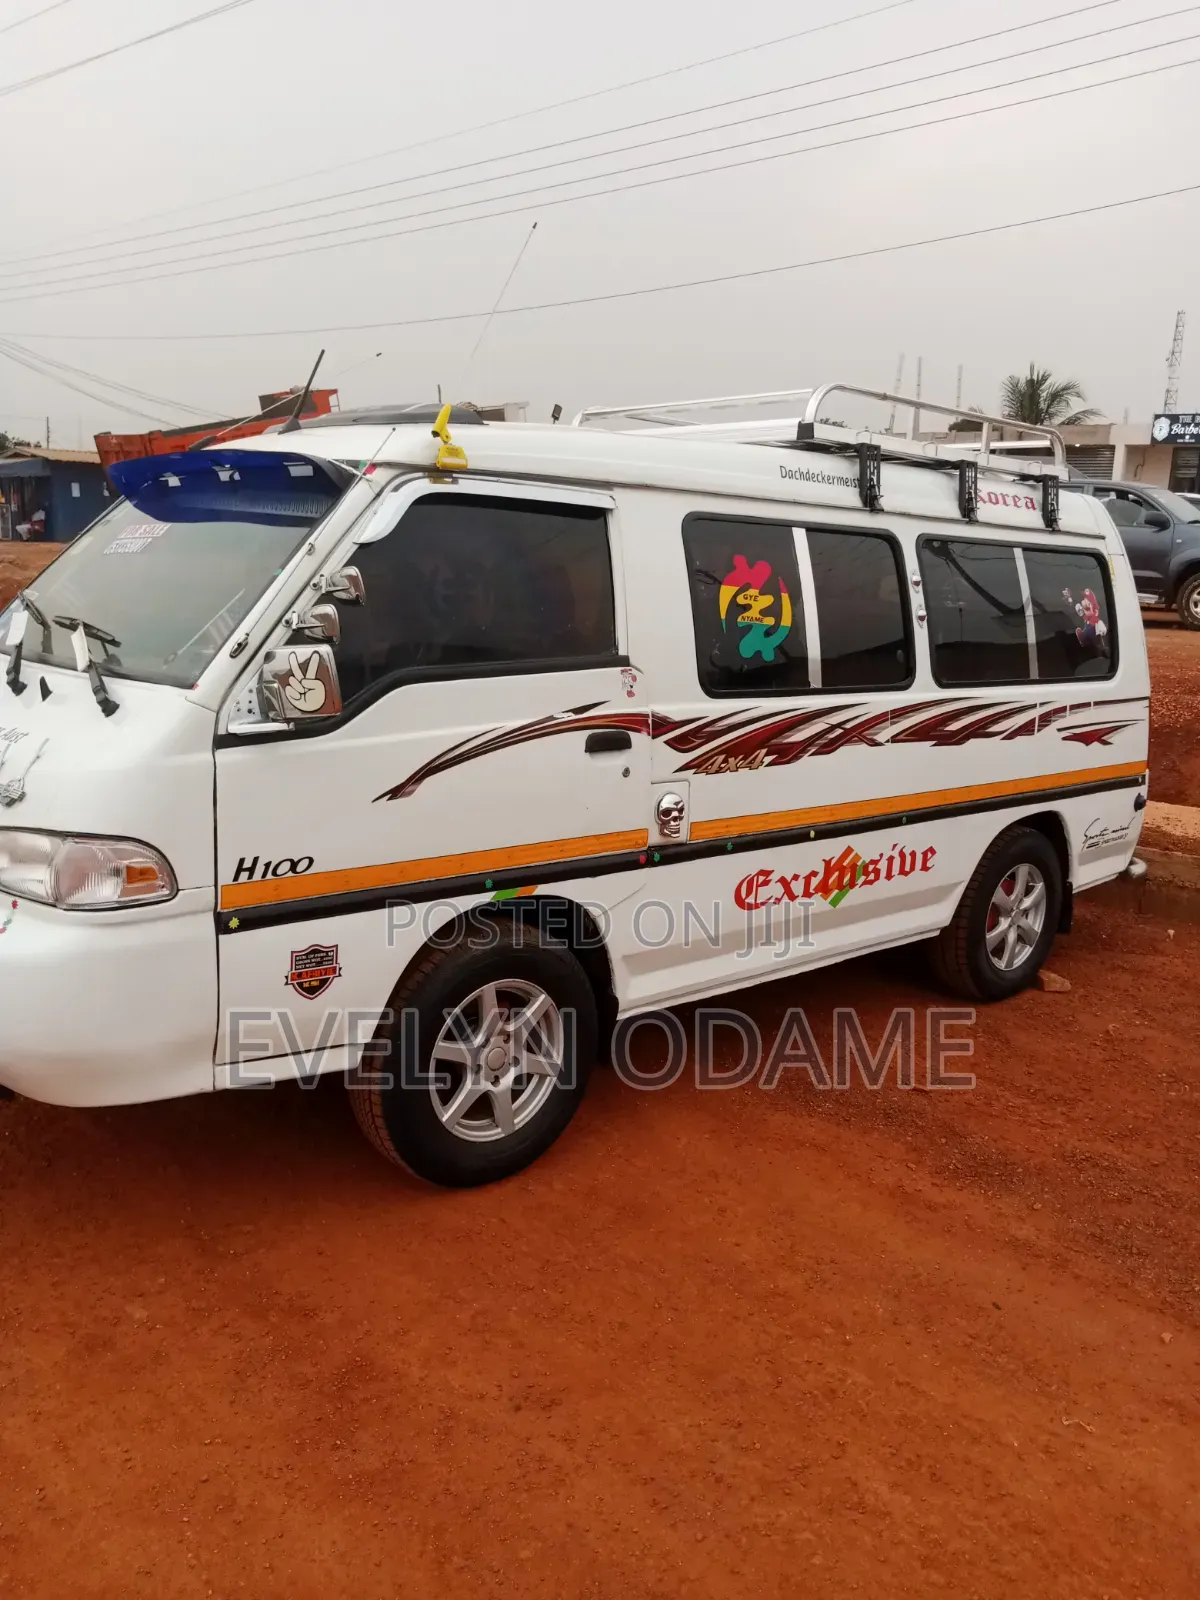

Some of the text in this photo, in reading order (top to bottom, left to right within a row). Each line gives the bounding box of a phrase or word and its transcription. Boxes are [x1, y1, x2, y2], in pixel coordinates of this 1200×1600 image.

[137, 523, 171, 537] SALE
[742, 593, 760, 602] GYE
[693, 748, 769, 775] 4x4
[734, 842, 937, 911] Exclusive
